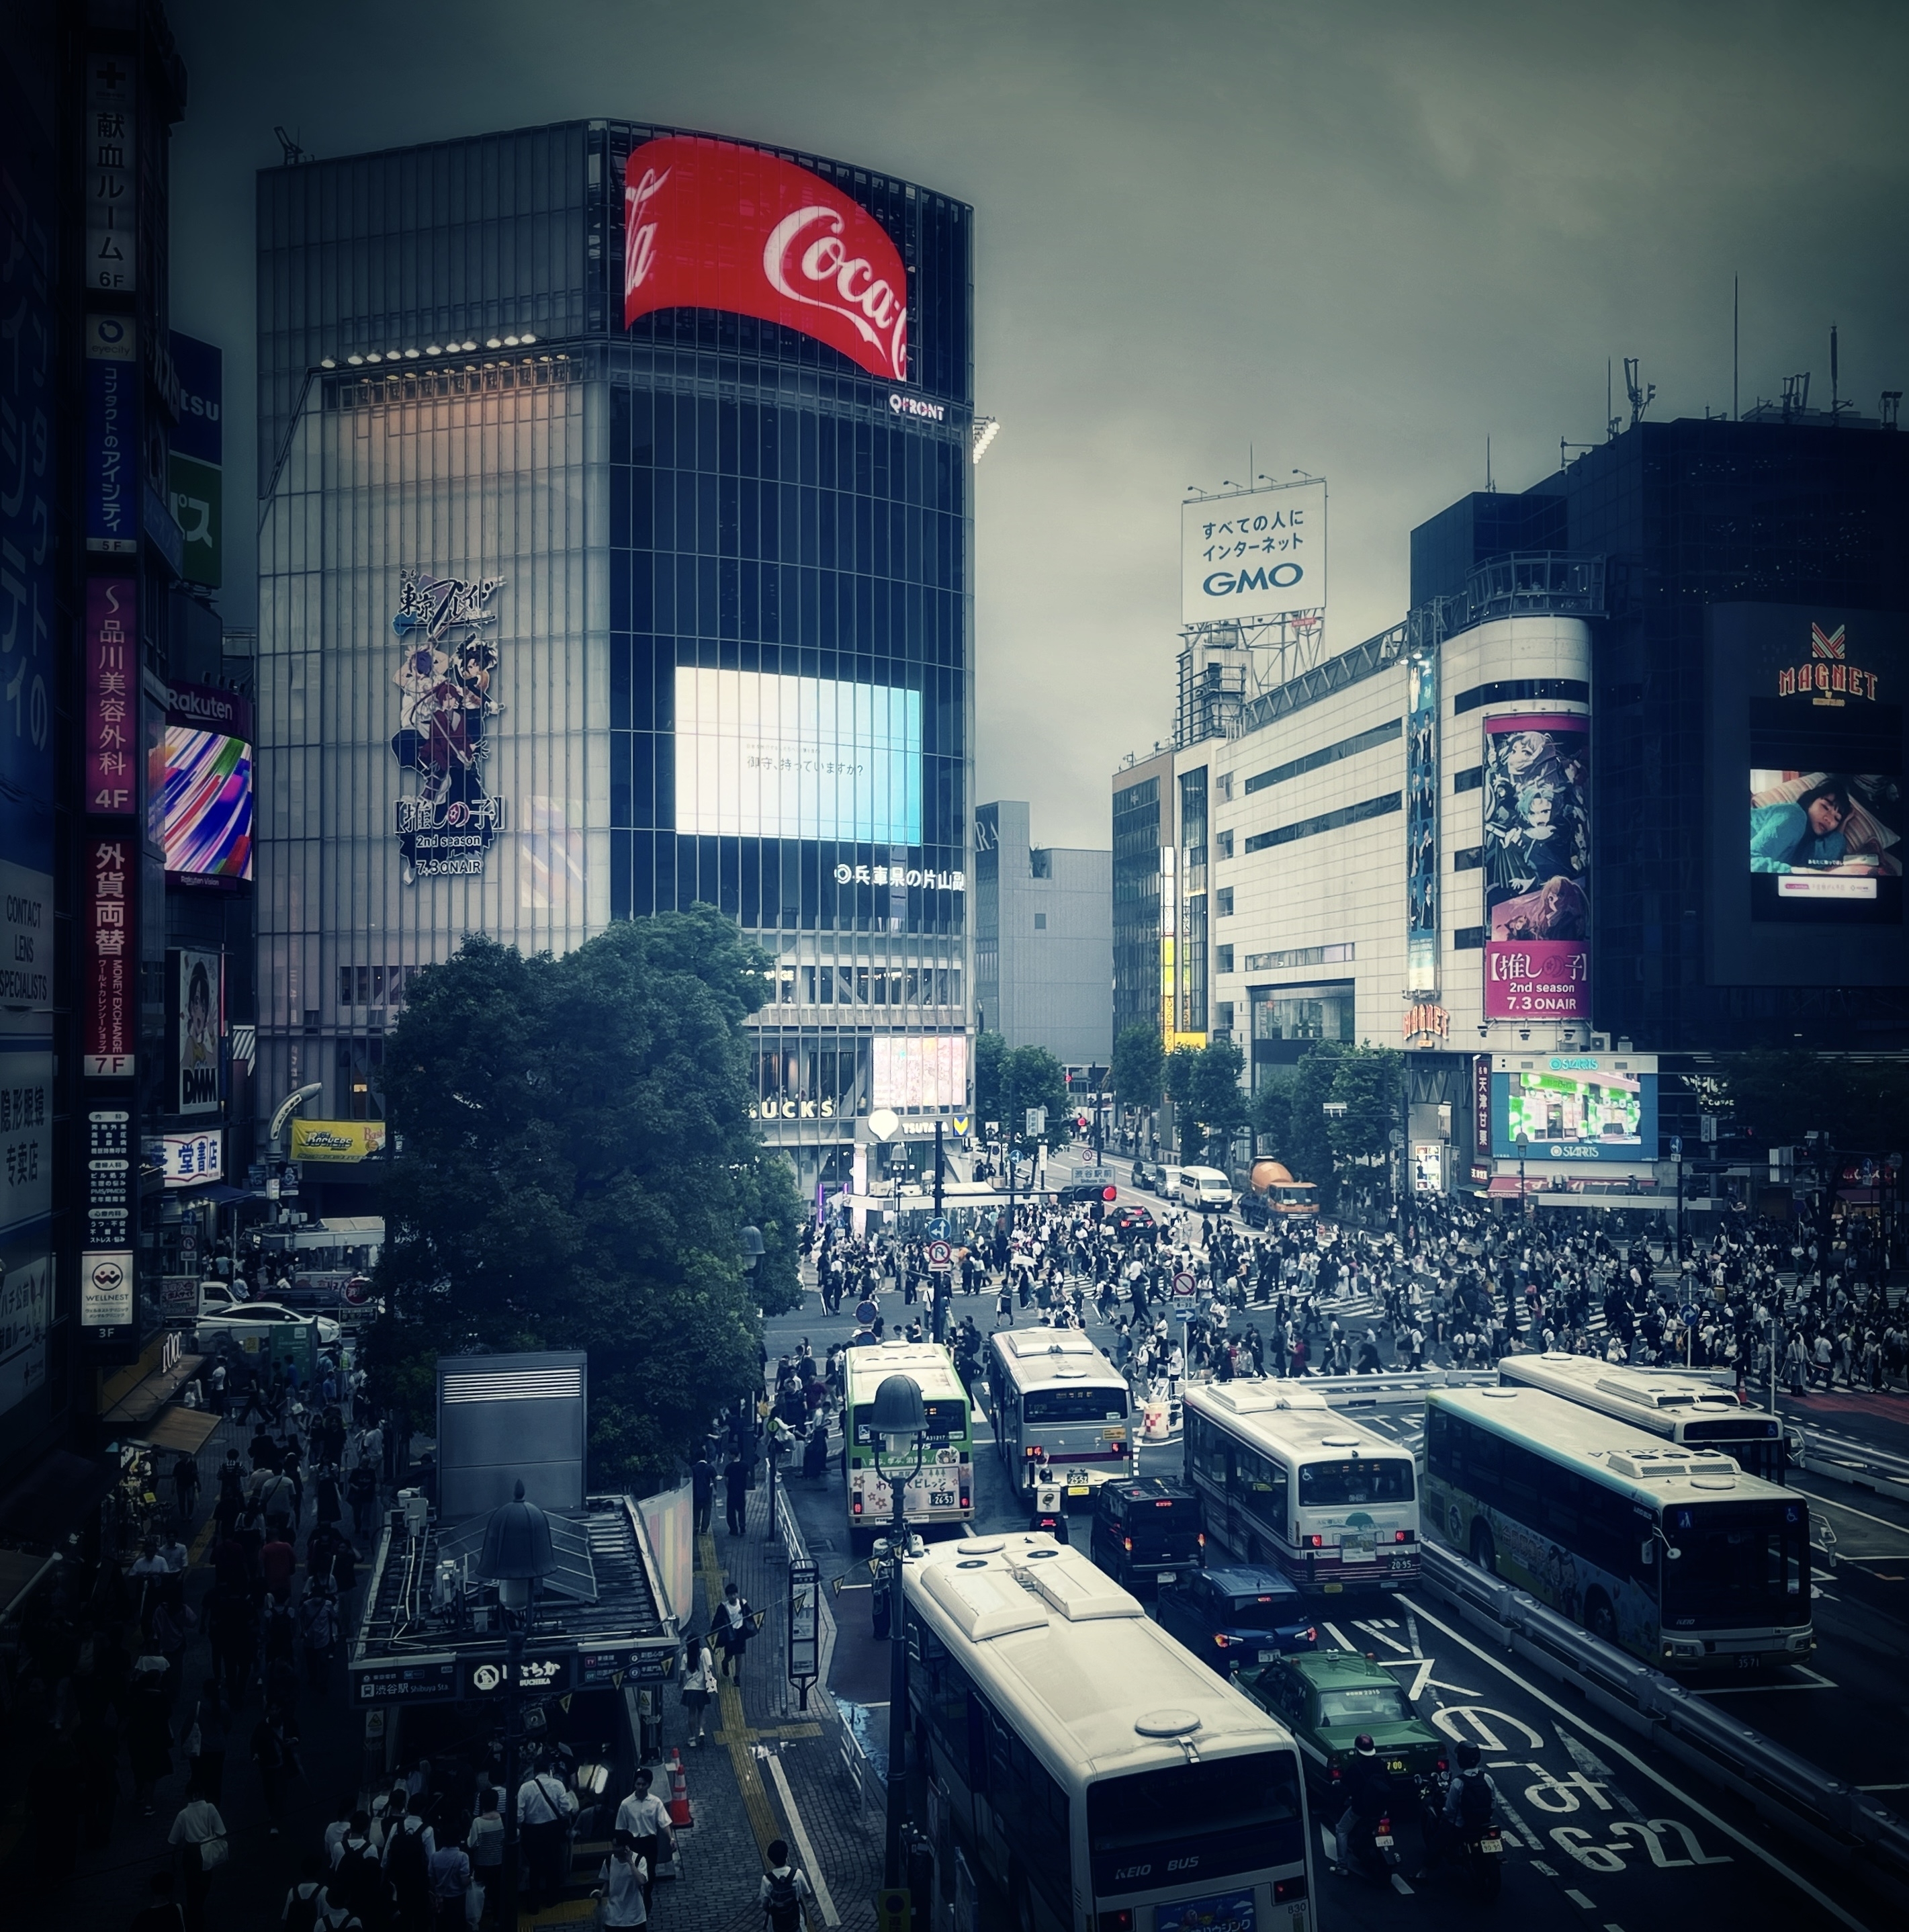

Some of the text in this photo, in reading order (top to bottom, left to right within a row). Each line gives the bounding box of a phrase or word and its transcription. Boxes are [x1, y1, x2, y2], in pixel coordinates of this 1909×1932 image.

[97, 113, 125, 261] 献血ルーム
[99, 272, 124, 287] 6F
[92, 344, 130, 356] eyecity
[889, 394, 944, 421] QFRONT
[101, 367, 121, 532] コンタクトのアイシティ
[1203, 510, 1303, 539] すべての人に
[1203, 533, 1304, 562] インターネット
[1202, 562, 1304, 597] GMO
[1779, 663, 1878, 701] MAGNET
[99, 619, 126, 777] 品川美容外科
[167, 689, 233, 721] Rakuten
[95, 789, 128, 808] 4F
[416, 835, 482, 848] 2nd season
[181, 876, 219, 886] Rakuten Vision
[7, 895, 42, 929] CONTACT
[95, 843, 125, 956] 外貨両替
[14, 934, 34, 963] LENS
[0, 969, 48, 1001] SPECIALISTS
[1509, 982, 1574, 993] 2nd season
[98, 959, 107, 1053] ワールドカレンシーショップ
[112, 959, 123, 1053] MONEY EXCHANGE
[1403, 1004, 1450, 1041] MAGNET
[95, 1057, 125, 1073] 7F
[183, 1067, 217, 1105] DMM
[301, 1131, 353, 1148] ROCKERS
[902, 1122, 949, 1135] TSUTAA
[1075, 1170, 1112, 1178] 渋谷駅前
[99, 1328, 115, 1337] 3F
[376, 1683, 408, 1695] 渋谷駅
[410, 1684, 436, 1693] Shibuya
[1549, 1818, 1734, 1872] 6-22
[1115, 1856, 1199, 1880] KEIO BUS
[1288, 1902, 1306, 1915] 830
